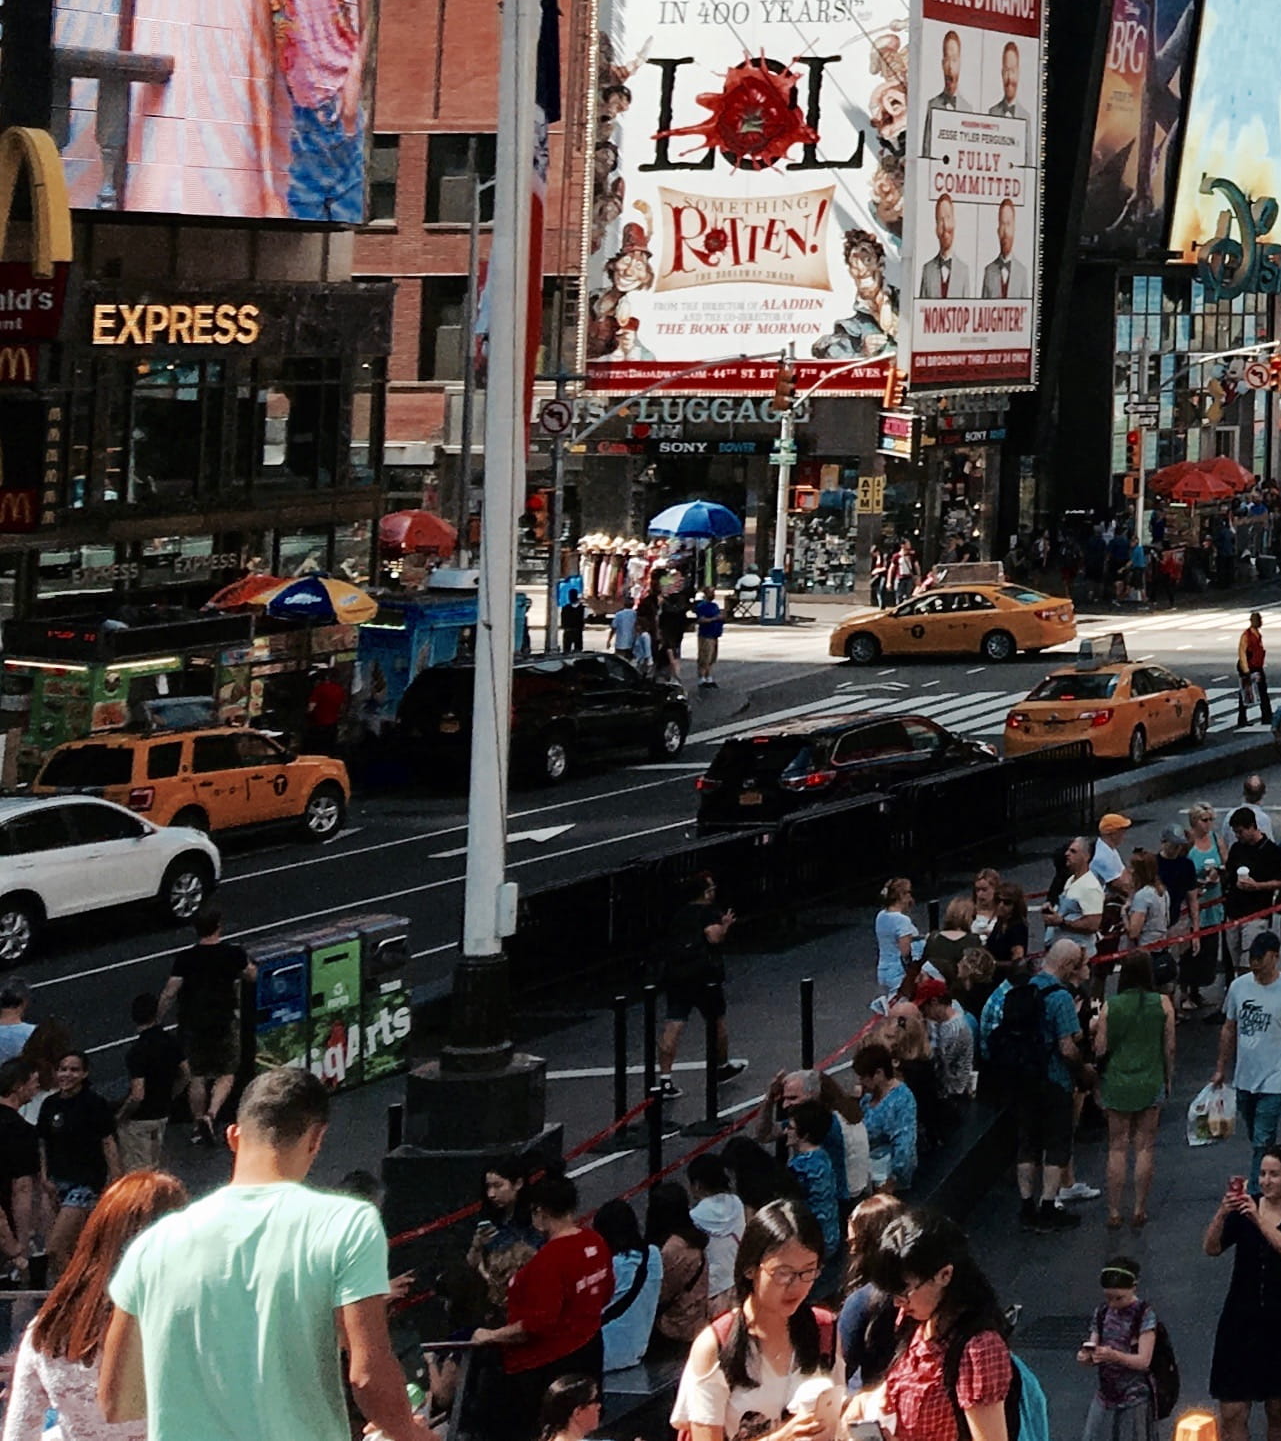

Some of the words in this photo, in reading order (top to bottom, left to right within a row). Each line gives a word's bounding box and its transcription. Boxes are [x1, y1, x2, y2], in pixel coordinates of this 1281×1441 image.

[657, 0, 689, 26] IN
[696, 0, 750, 26] 400
[1108, 21, 1147, 73] BFG
[958, 150, 1000, 171] FULLY
[935, 172, 1020, 197] COMMITTED
[682, 194, 809, 215] SOMETHING
[760, 298, 824, 310] ALADDIN
[92, 304, 259, 344] EXPRESS
[657, 322, 685, 335] THE
[688, 322, 732, 335] BOOK
[734, 322, 752, 335] OF
[756, 322, 821, 335] MORMON
[659, 443, 707, 453] SONY
[860, 479, 871, 508] ATM
[72, 562, 138, 584] EXPRESS
